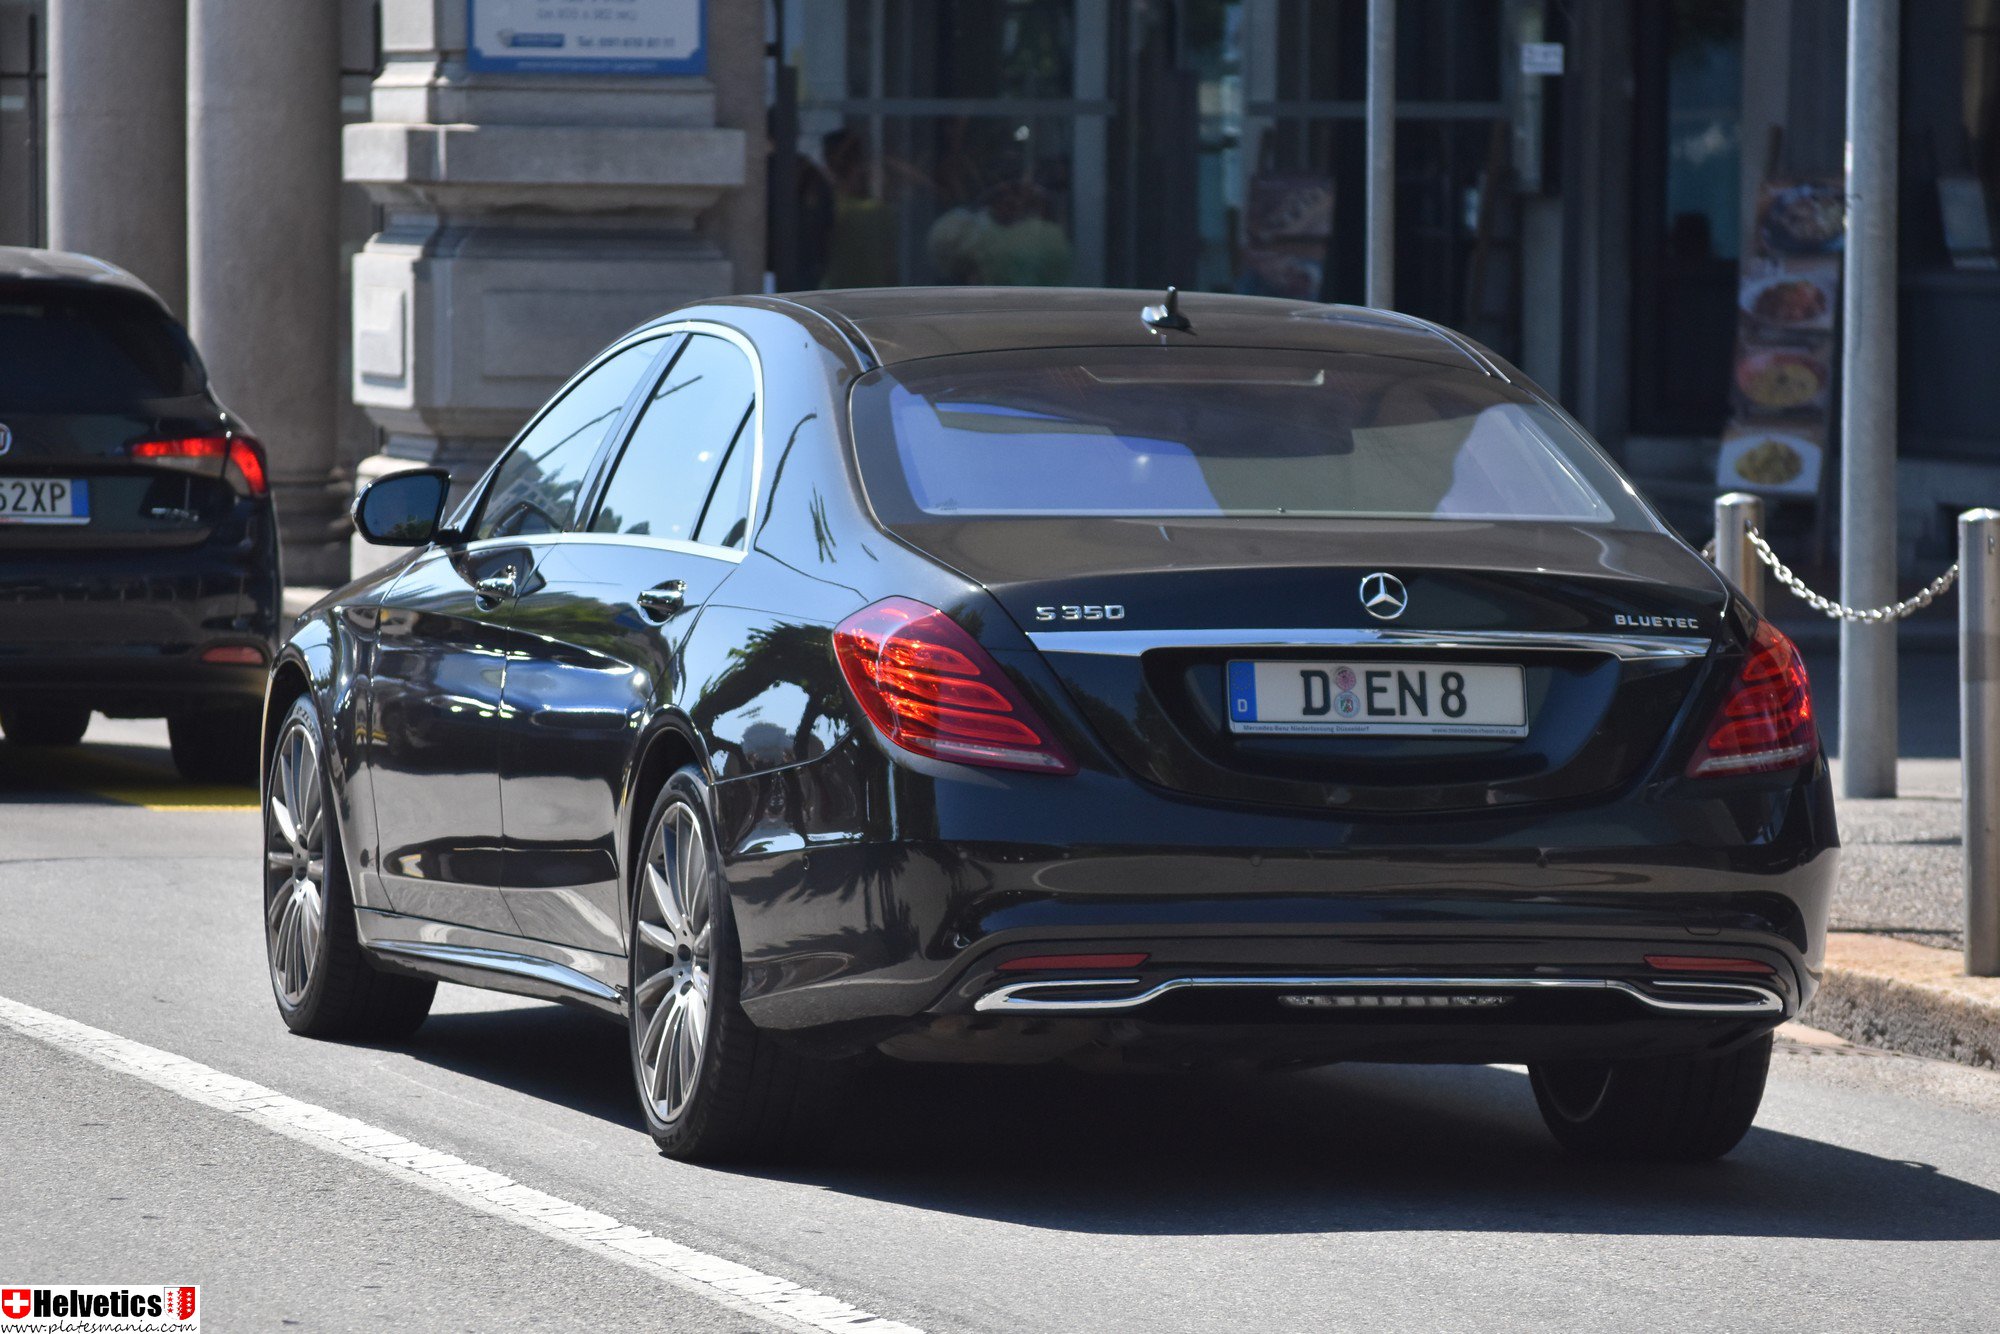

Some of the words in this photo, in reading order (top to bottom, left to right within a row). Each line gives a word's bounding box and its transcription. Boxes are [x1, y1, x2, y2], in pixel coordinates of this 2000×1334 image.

[1036, 606, 1057, 621] S
[1061, 605, 1125, 620] 350
[1614, 614, 1699, 629] BLUETEC
[1300, 669, 1332, 716] D
[1440, 671, 1467, 718] 8
[1237, 698, 1248, 712] D
